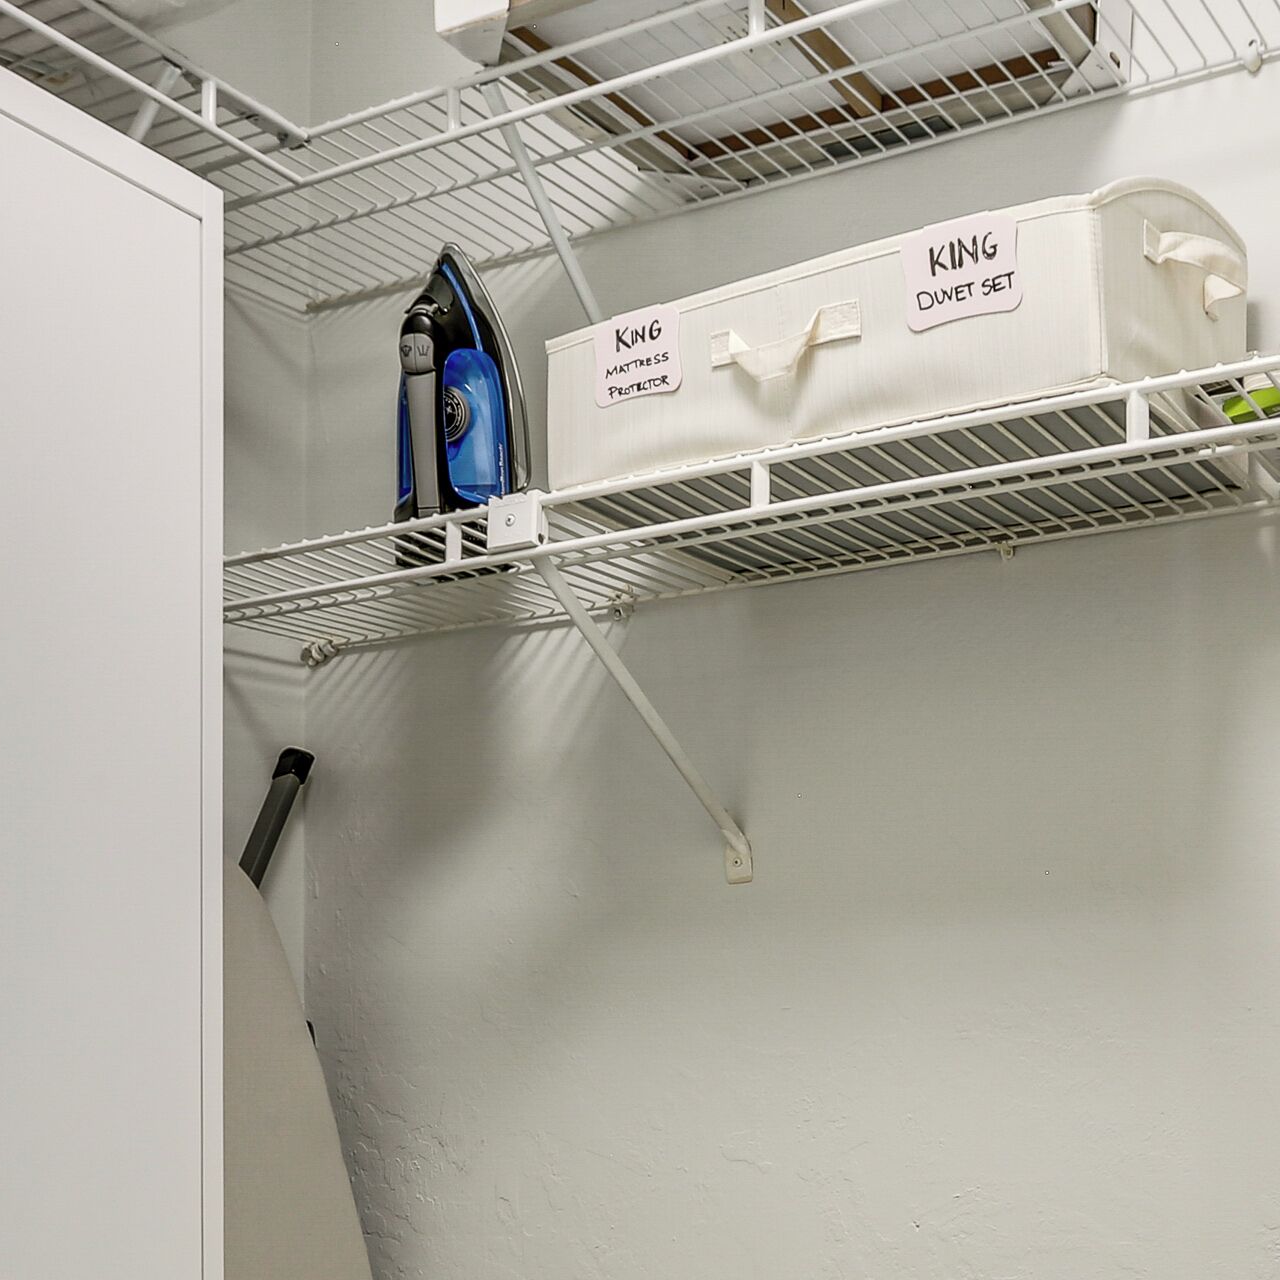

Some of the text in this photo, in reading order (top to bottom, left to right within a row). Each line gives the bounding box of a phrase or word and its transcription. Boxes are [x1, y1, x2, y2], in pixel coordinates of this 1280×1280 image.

[929, 231, 998, 277] KING
[916, 271, 1015, 311] DUVET SET
[615, 319, 662, 353] KING
[605, 351, 670, 379] MATTRESS
[608, 375, 670, 399] PROTECTOR
